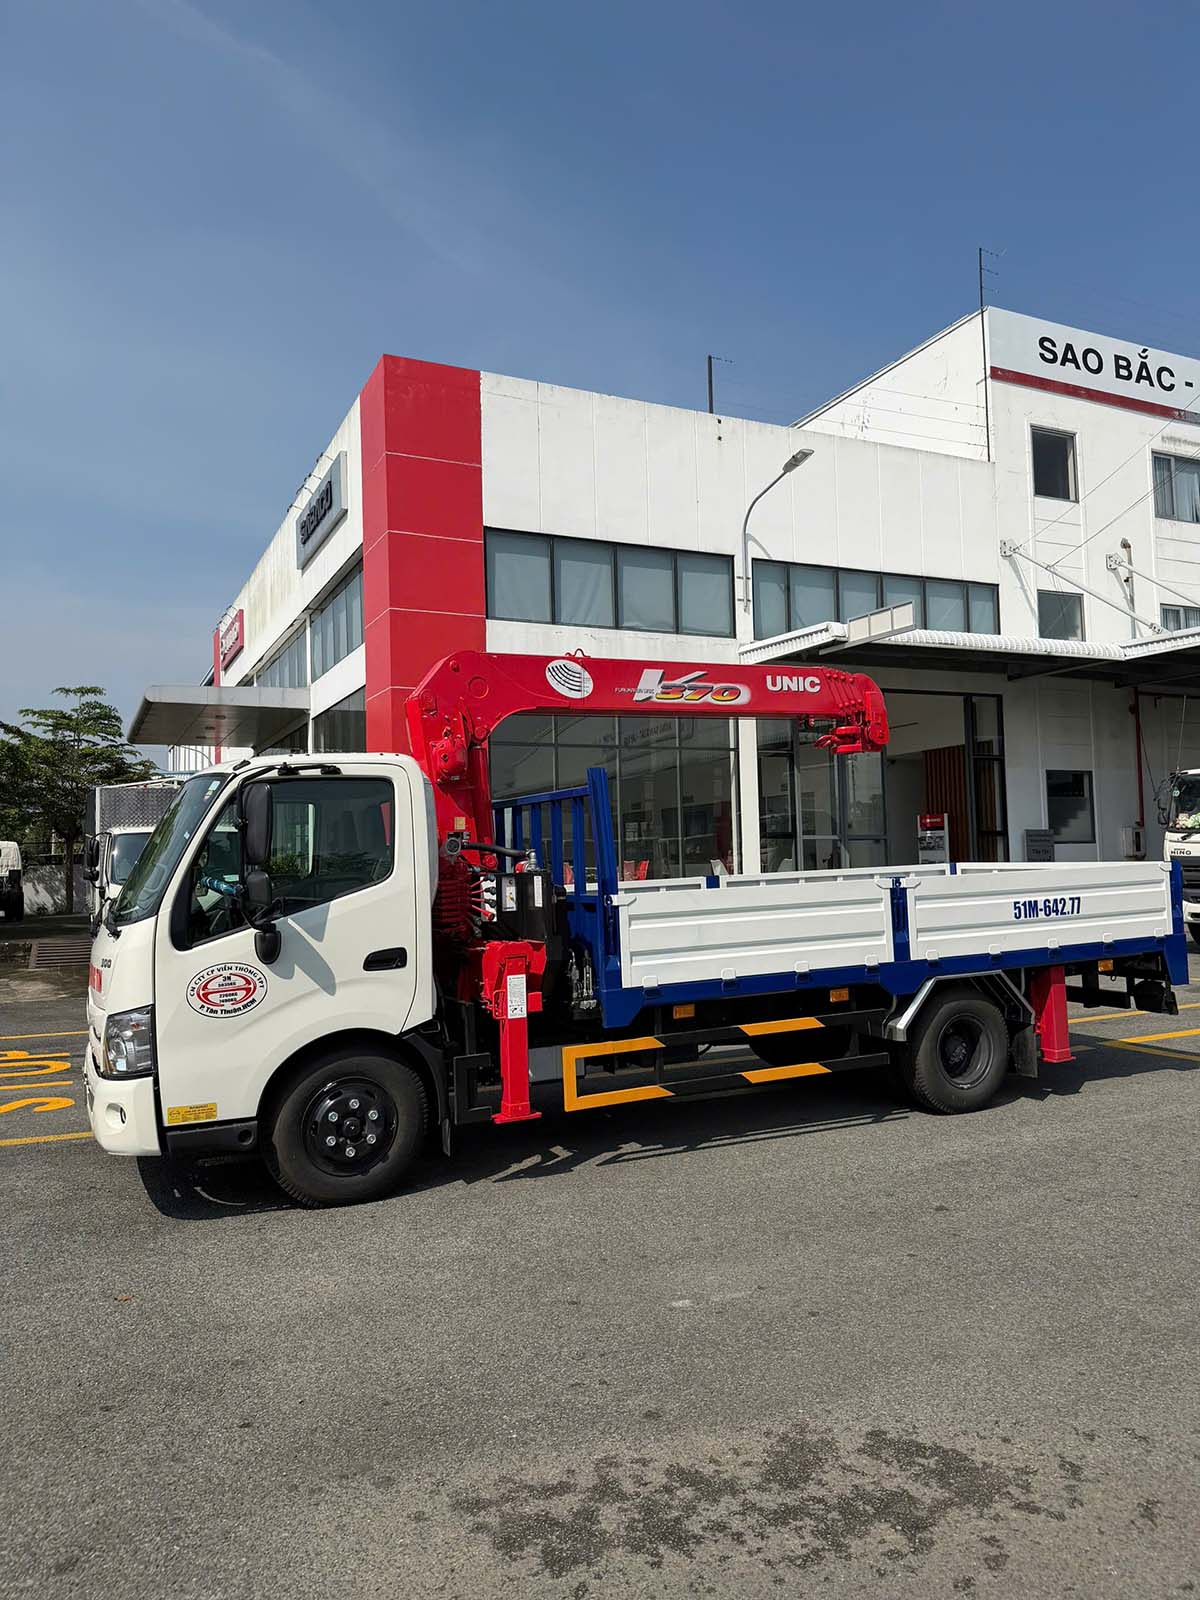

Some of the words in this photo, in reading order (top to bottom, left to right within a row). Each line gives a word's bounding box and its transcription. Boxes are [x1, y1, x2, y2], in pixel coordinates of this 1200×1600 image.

[1038, 336, 1104, 375] SAO
[1113, 348, 1176, 392] BẮC
[765, 675, 821, 693] UNIC
[1013, 896, 1081, 920] 51M-642.77
